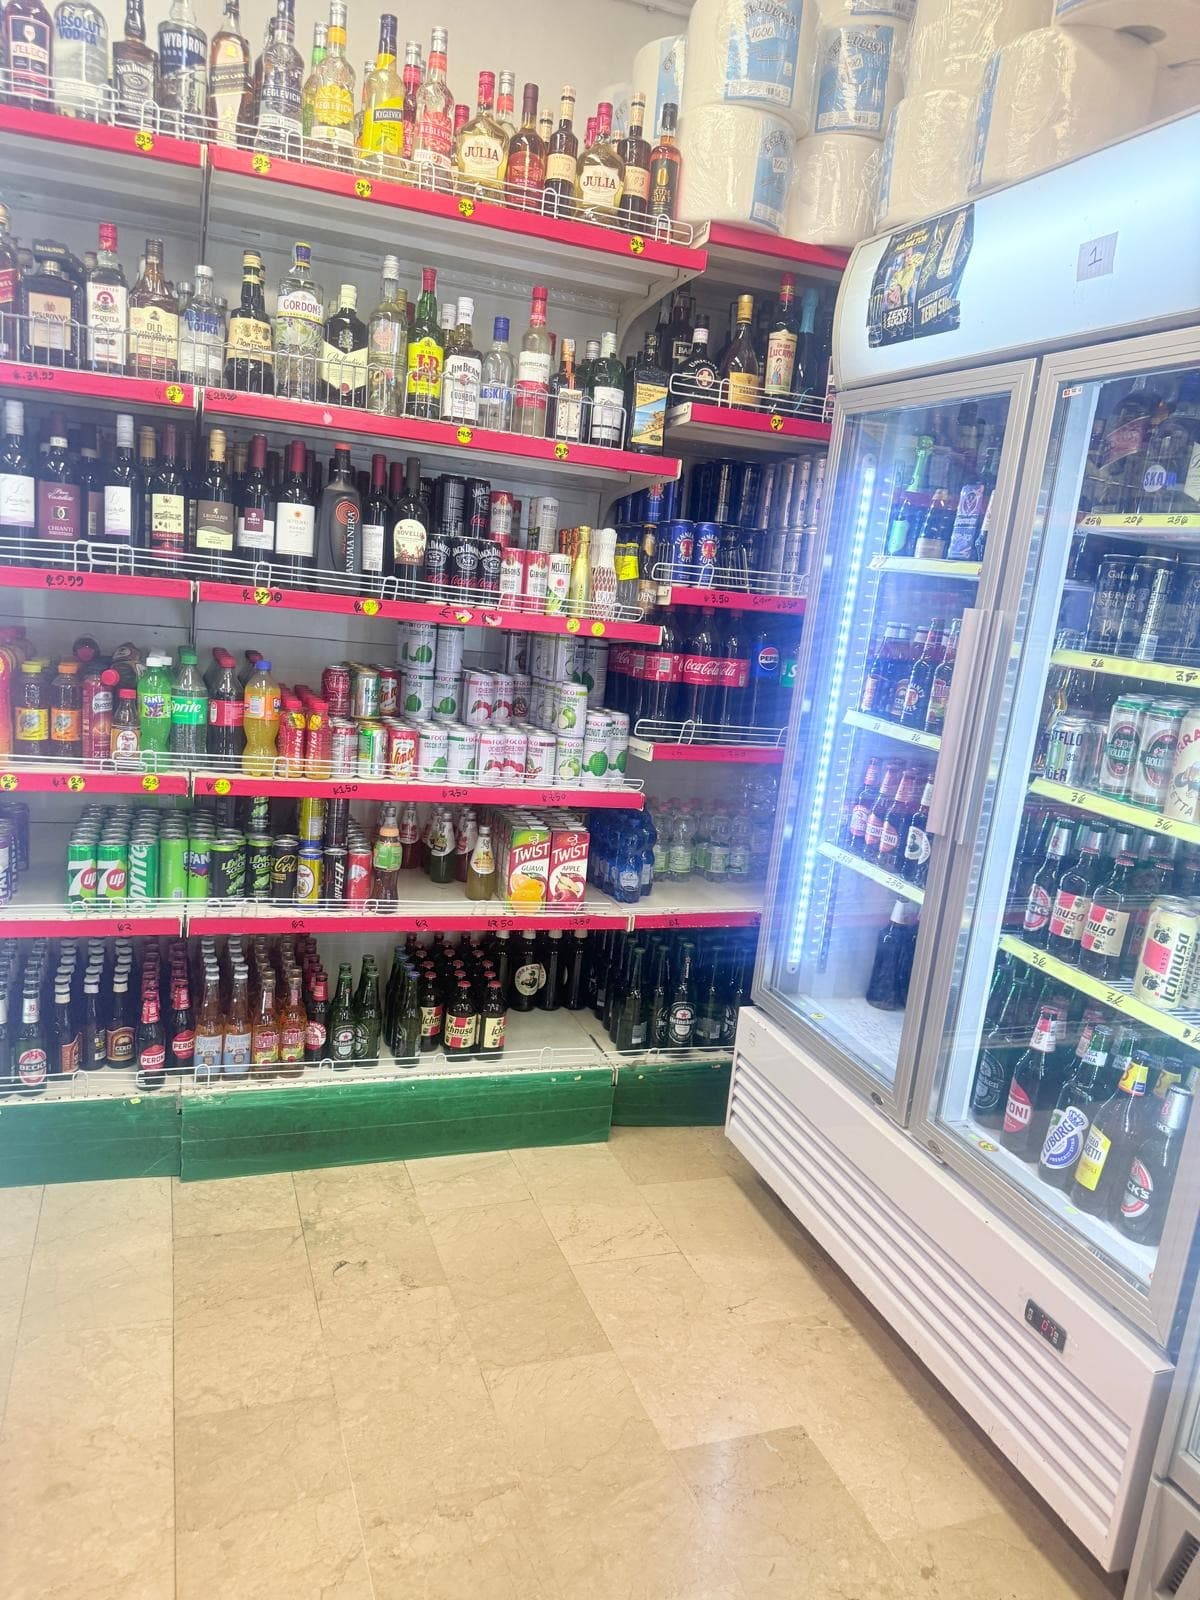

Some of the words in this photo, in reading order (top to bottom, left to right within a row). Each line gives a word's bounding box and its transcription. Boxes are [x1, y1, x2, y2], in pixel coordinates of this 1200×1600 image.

[56, 15, 101, 34] ABSOLUT
[58, 29, 98, 46] VODKA
[263, 88, 301, 104] KEGLEVICH
[464, 145, 499, 162] JULIA
[582, 174, 617, 190] JULIA
[1087, 246, 1104, 268] 1
[91, 315, 120, 324] TEQUILA
[887, 307, 909, 319] ZERO
[146, 322, 163, 333] OLD
[187, 321, 220, 336] VODKA
[451, 364, 463, 375] JIM
[463, 362, 481, 379] BEAM
[48, 525, 74, 534] CHIANTI
[346, 510, 356, 574] ANIMANERA
[171, 699, 202, 714] Sprite
[1048, 769, 1069, 783] GER
[1071, 793, 1087, 804] 3€
[1154, 818, 1174, 832] 3€
[190, 852, 210, 865] FAN
[513, 841, 550, 863] TWIST
[552, 843, 589, 864] TWIST
[521, 864, 545, 873] GUAVA
[561, 865, 581, 873] APPLE
[1032, 953, 1047, 968] 3€
[1158, 933, 1191, 1004] Ichnusa
[1007, 1103, 1030, 1121] ONI
